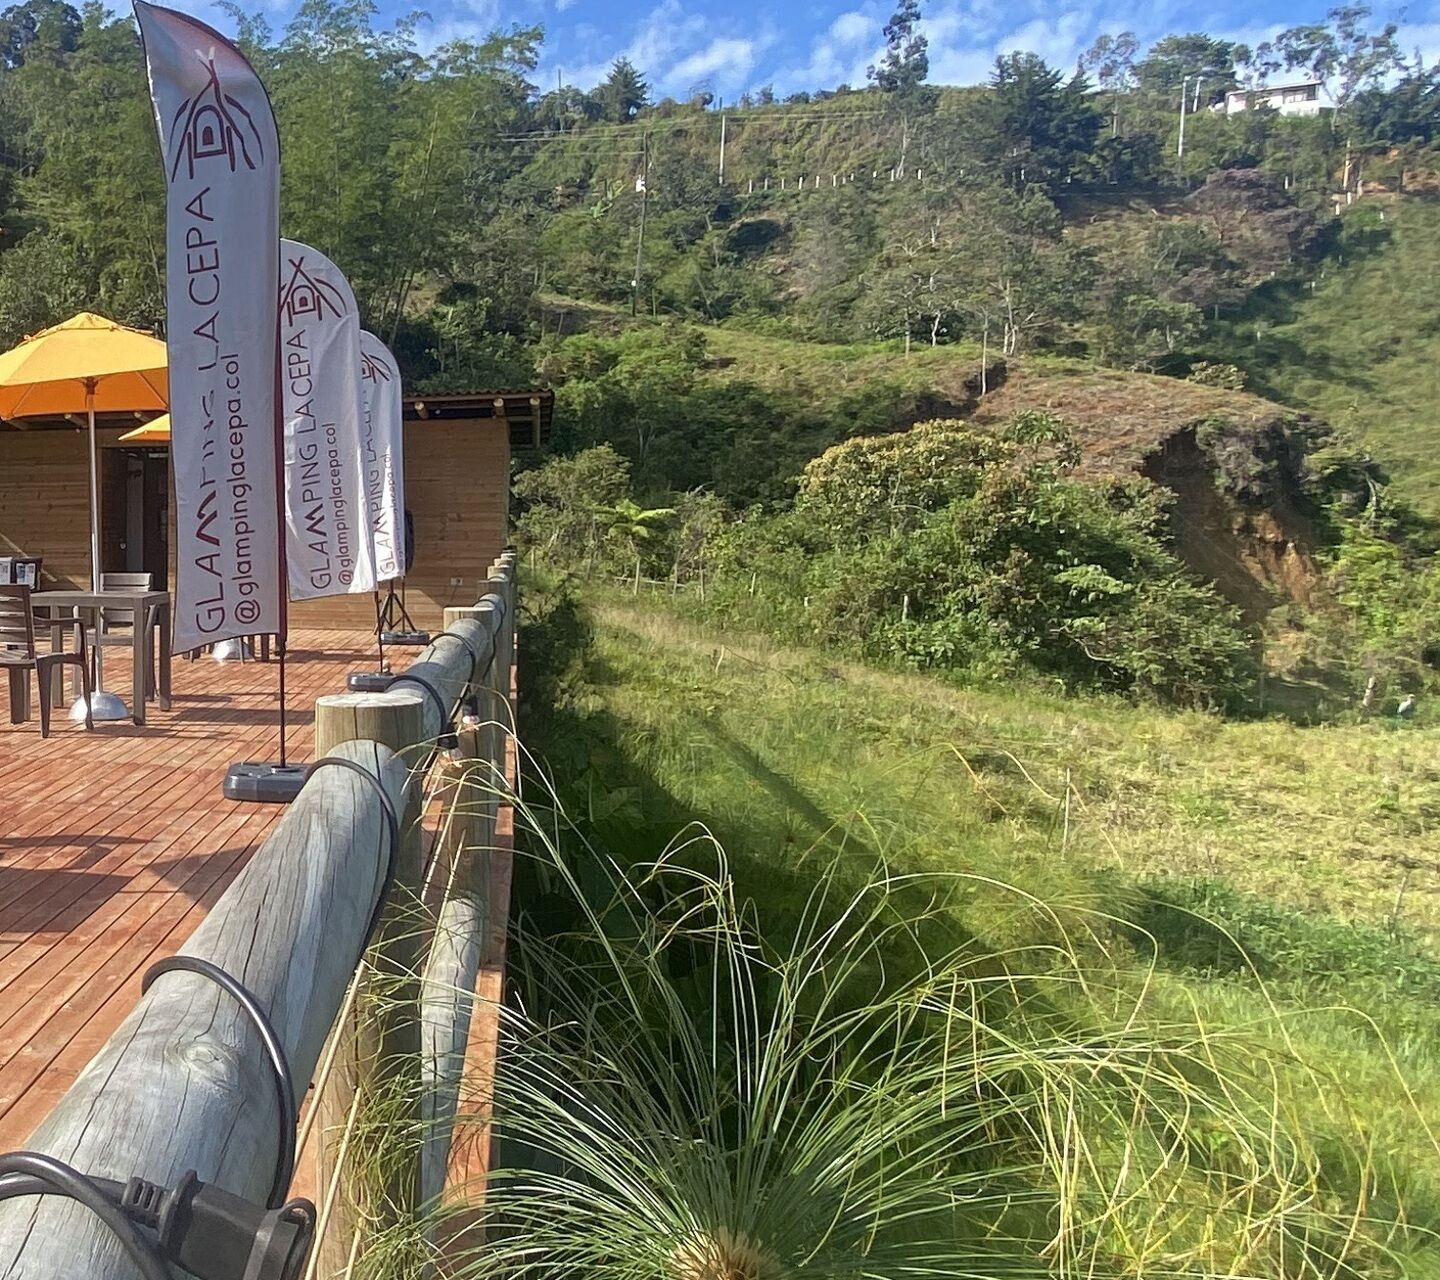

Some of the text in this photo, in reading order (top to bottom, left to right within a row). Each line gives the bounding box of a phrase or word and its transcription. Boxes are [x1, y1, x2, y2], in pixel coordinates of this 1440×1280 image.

[220, 353, 261, 625] @glampinglacepa.col
[299, 443, 332, 590] GLAMPING
[321, 423, 354, 586] @glampinglacepa.col
